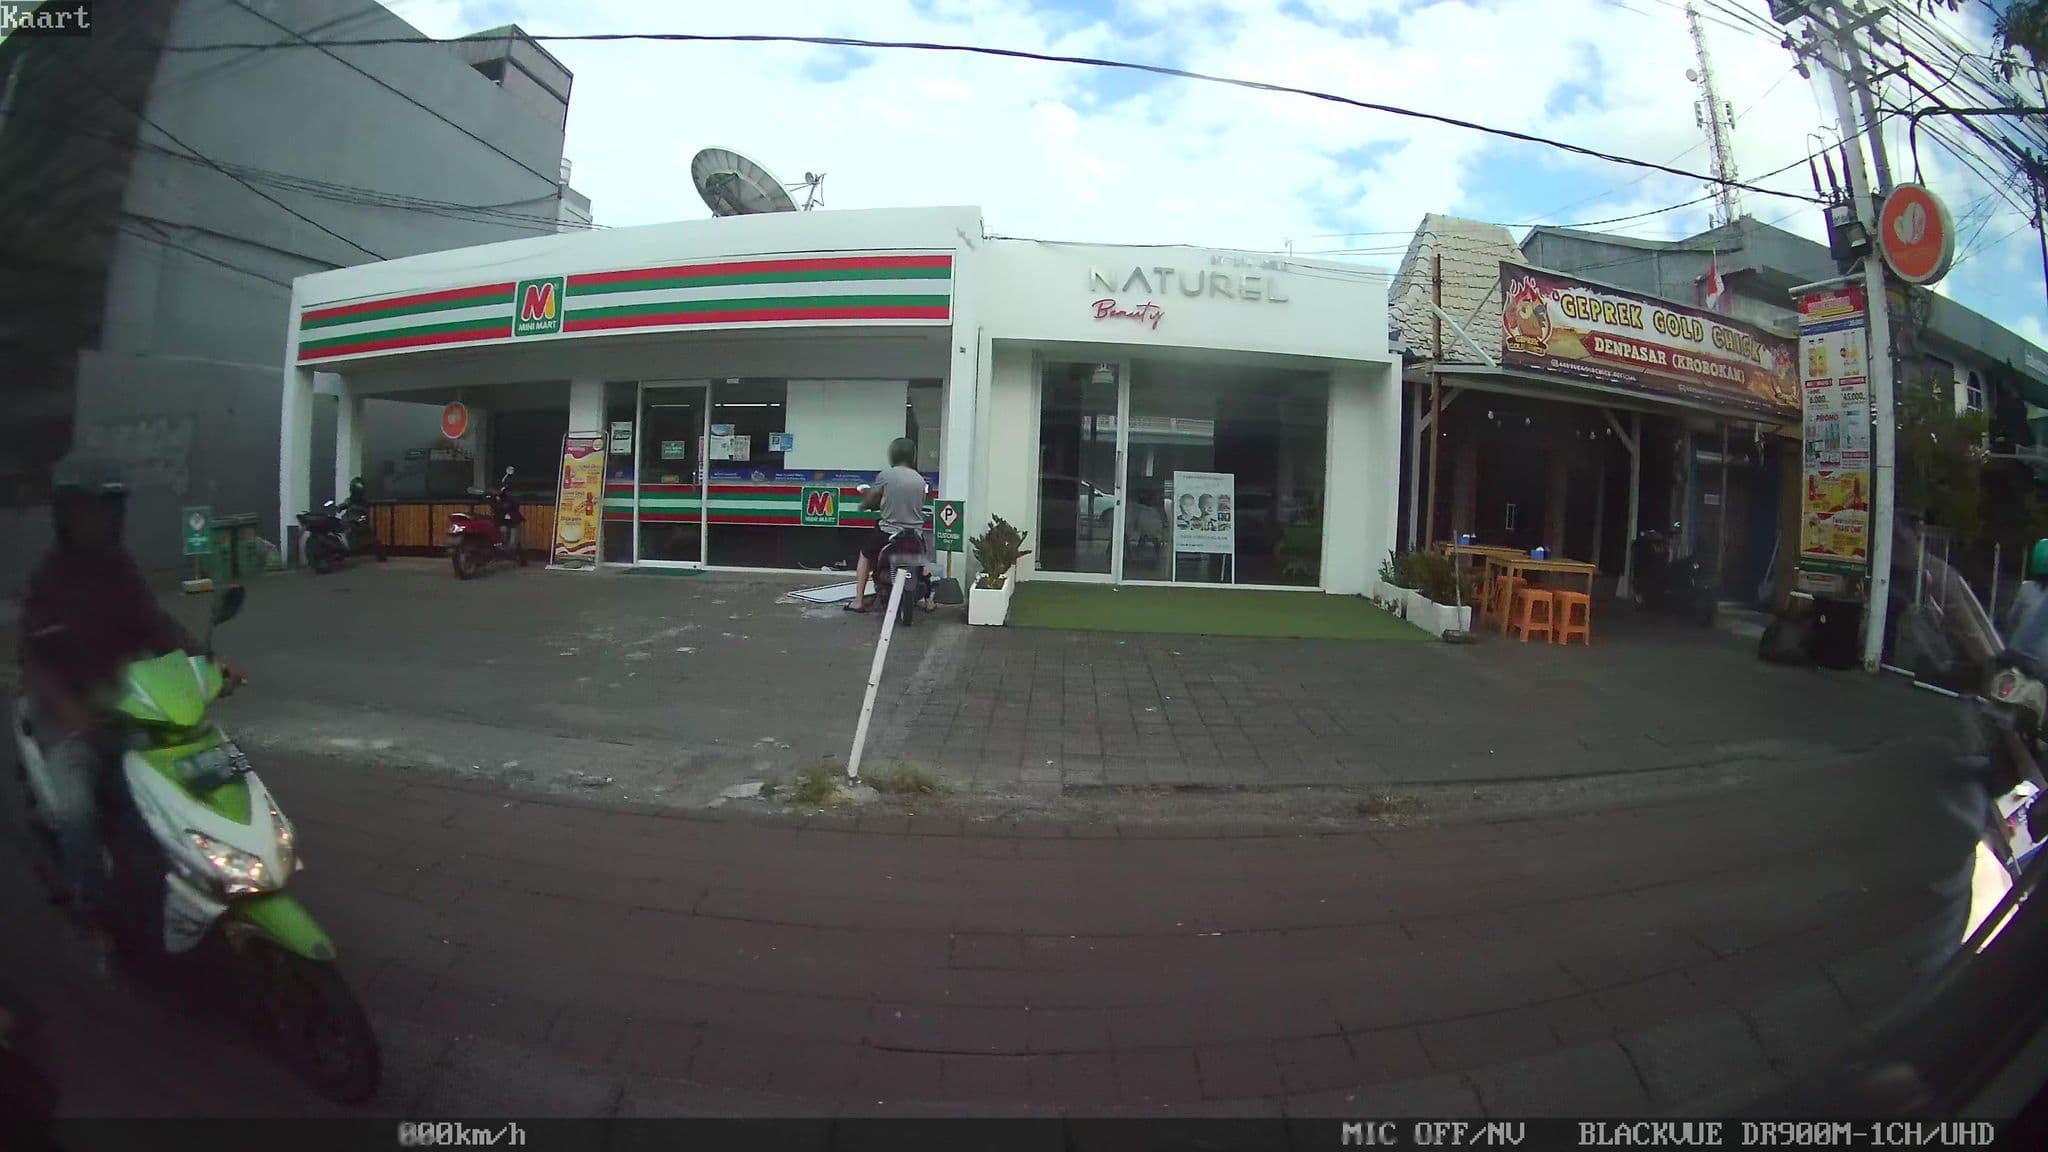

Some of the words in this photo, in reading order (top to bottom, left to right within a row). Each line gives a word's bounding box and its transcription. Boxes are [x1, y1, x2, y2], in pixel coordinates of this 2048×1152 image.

[1089, 265, 1289, 303] NATUREL
[519, 322, 535, 331] MINI
[536, 320, 557, 329] MART
[1091, 298, 1166, 330] Beauty
[1560, 293, 1643, 329] GEPREK
[1653, 310, 1704, 342] GOLD
[1711, 325, 1762, 363] CHICK
[1594, 336, 1668, 365] DENPASAR
[1672, 353, 1745, 384] (KROBOKAN)
[945, 507, 953, 520] P
